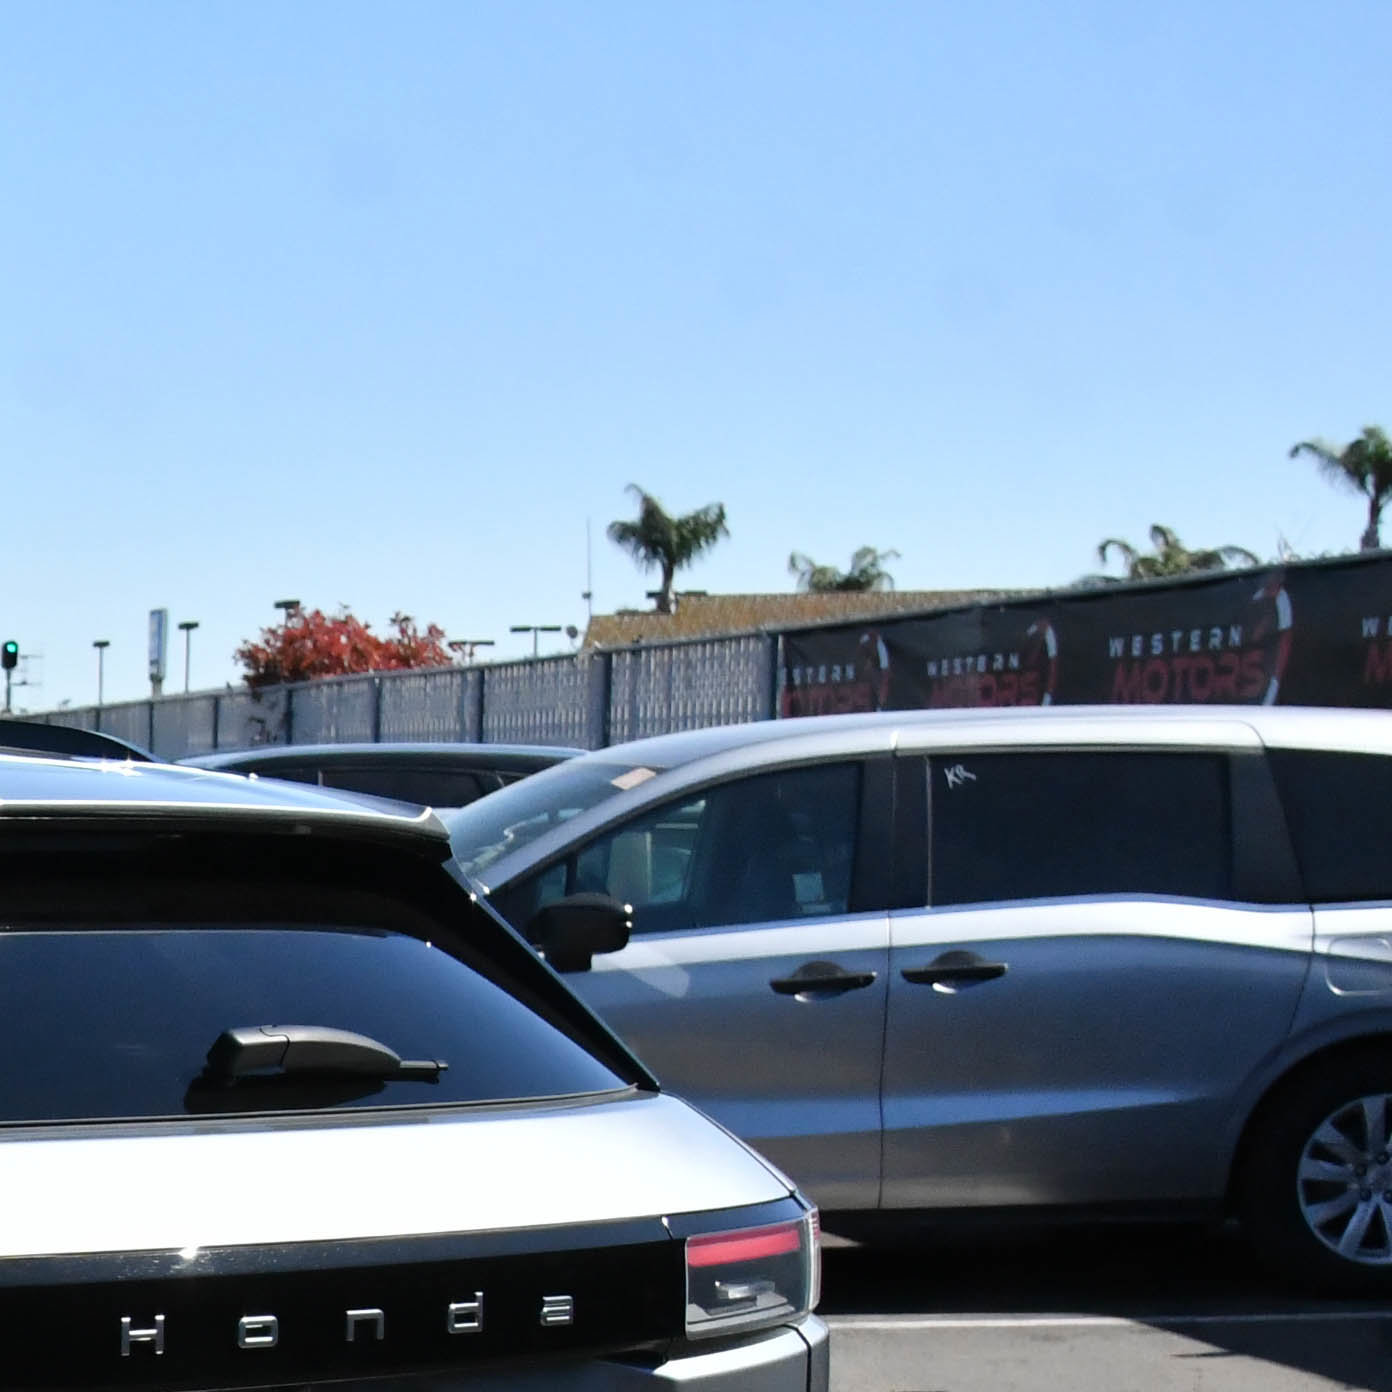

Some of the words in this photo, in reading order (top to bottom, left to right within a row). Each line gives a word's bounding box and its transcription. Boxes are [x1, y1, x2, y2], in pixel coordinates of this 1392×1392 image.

[1109, 624, 1243, 658] WESTERN
[927, 653, 1020, 677] WESTERN
[1112, 650, 1265, 703] MOTORS
